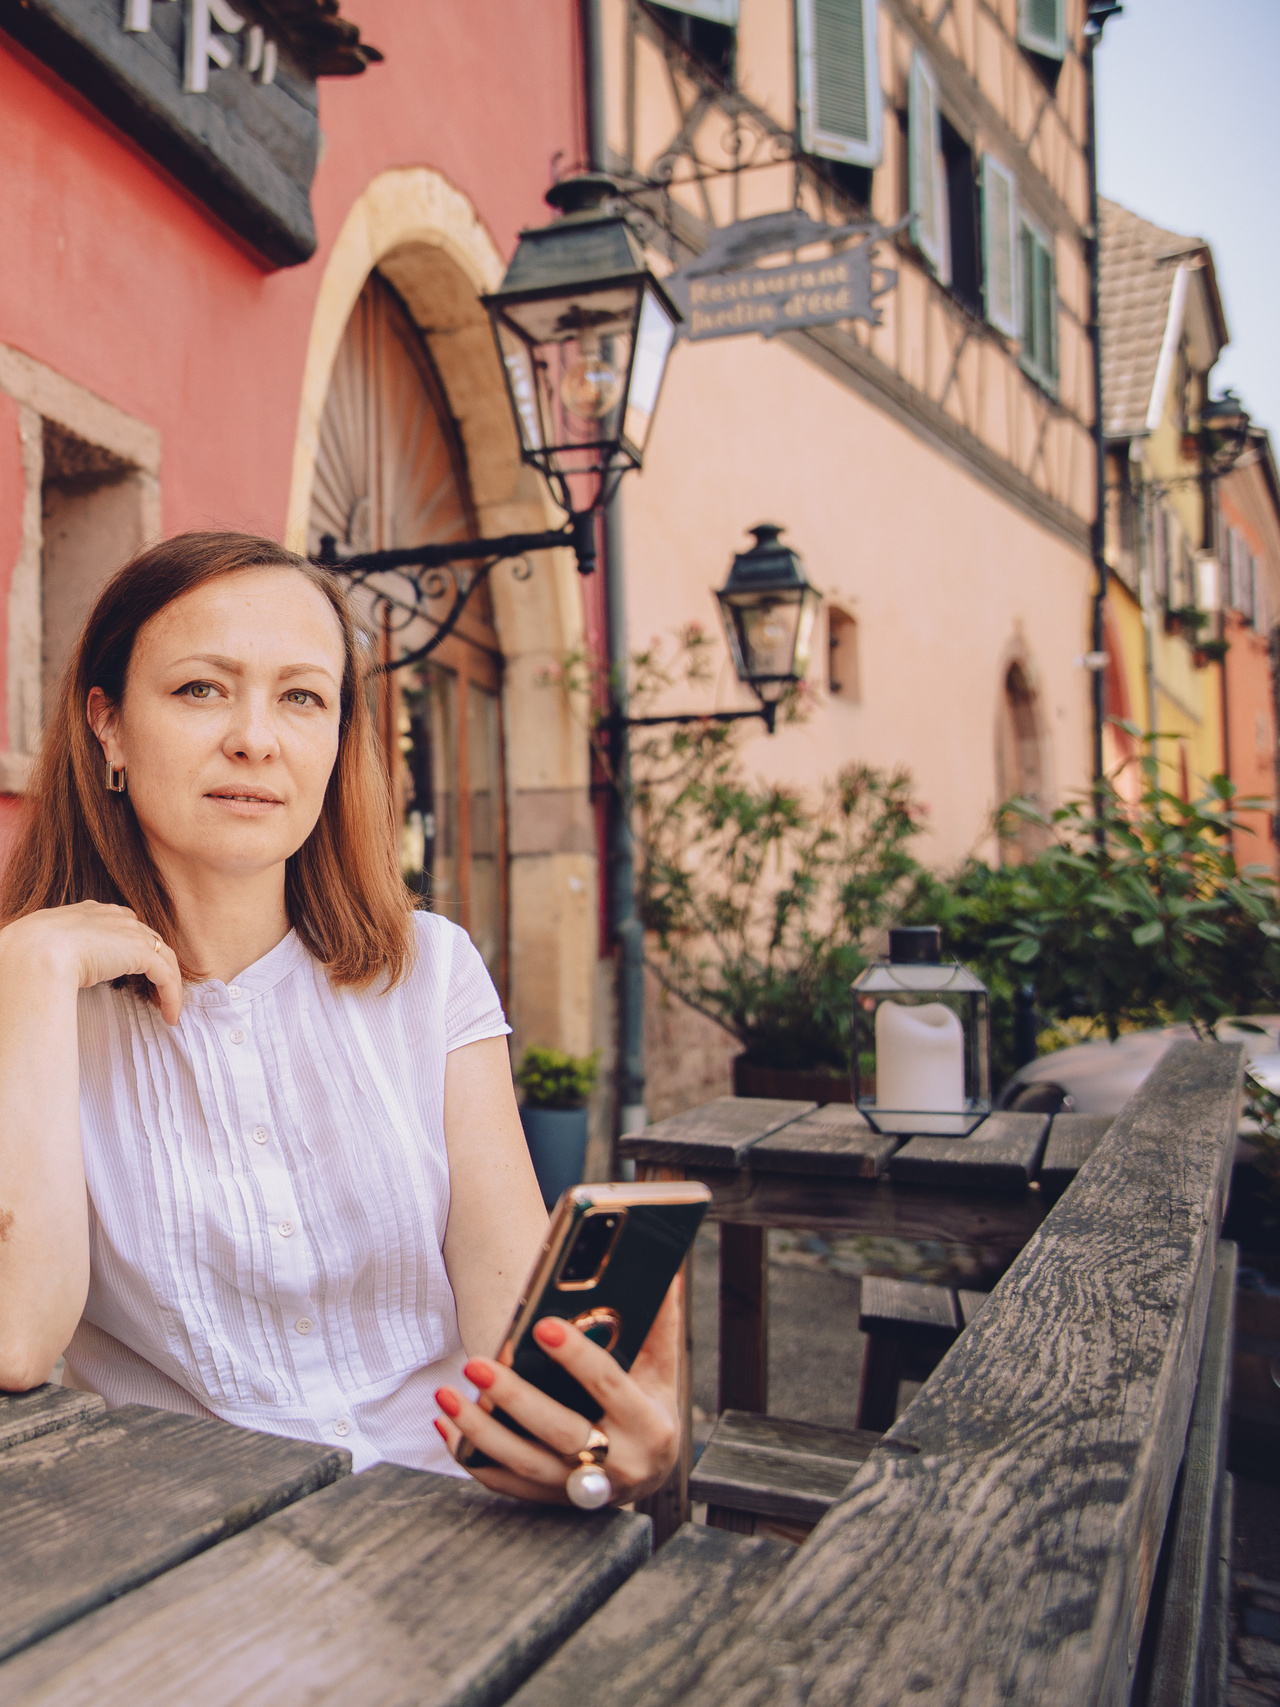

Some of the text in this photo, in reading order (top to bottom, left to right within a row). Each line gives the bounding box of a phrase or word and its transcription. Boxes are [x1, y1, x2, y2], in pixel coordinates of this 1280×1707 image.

[690, 265, 849, 302] Restaurant
[690, 286, 851, 335] Jardin d'été
